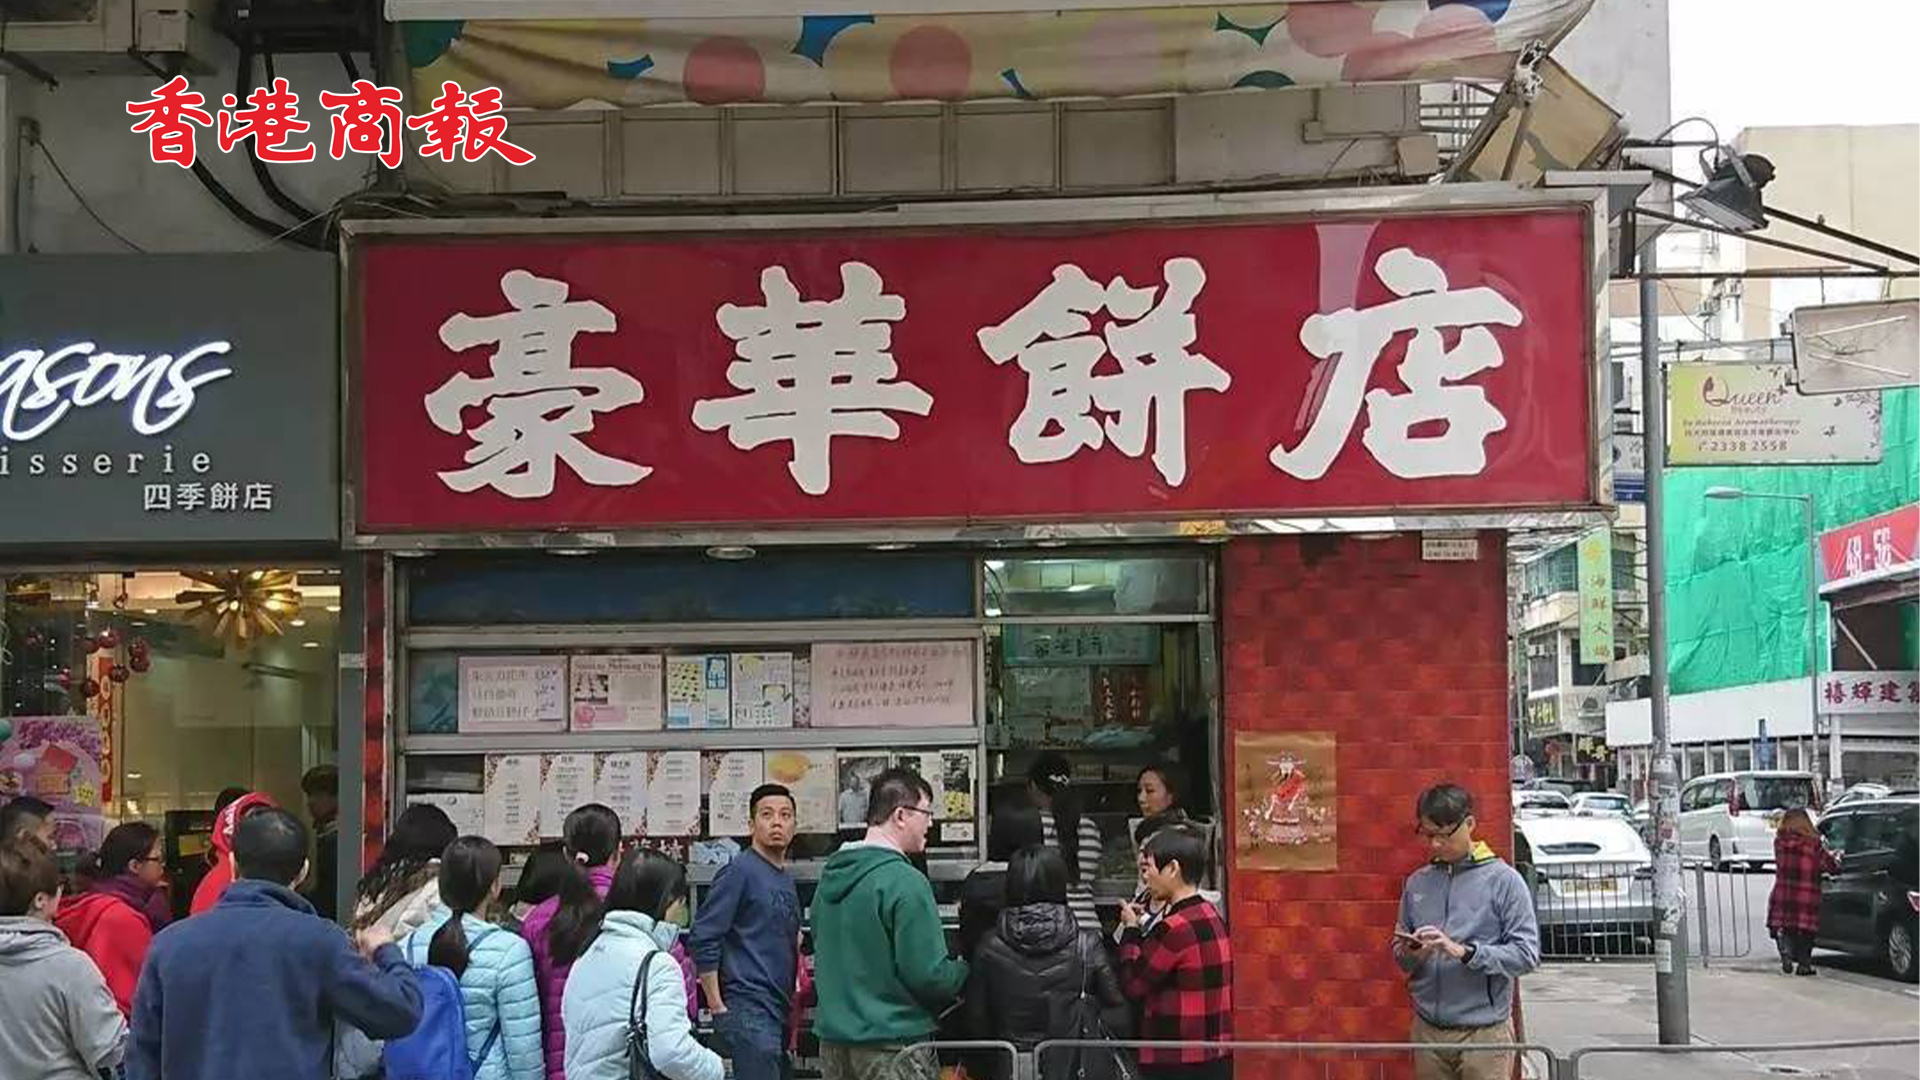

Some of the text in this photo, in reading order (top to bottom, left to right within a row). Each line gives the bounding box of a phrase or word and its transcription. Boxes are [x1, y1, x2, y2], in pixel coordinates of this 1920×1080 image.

[424, 247, 1524, 498] 豪華餅店
[0, 444, 212, 473] isserie
[1711, 441, 1787, 451] 2338 2558
[143, 483, 273, 512] 四季餅店
